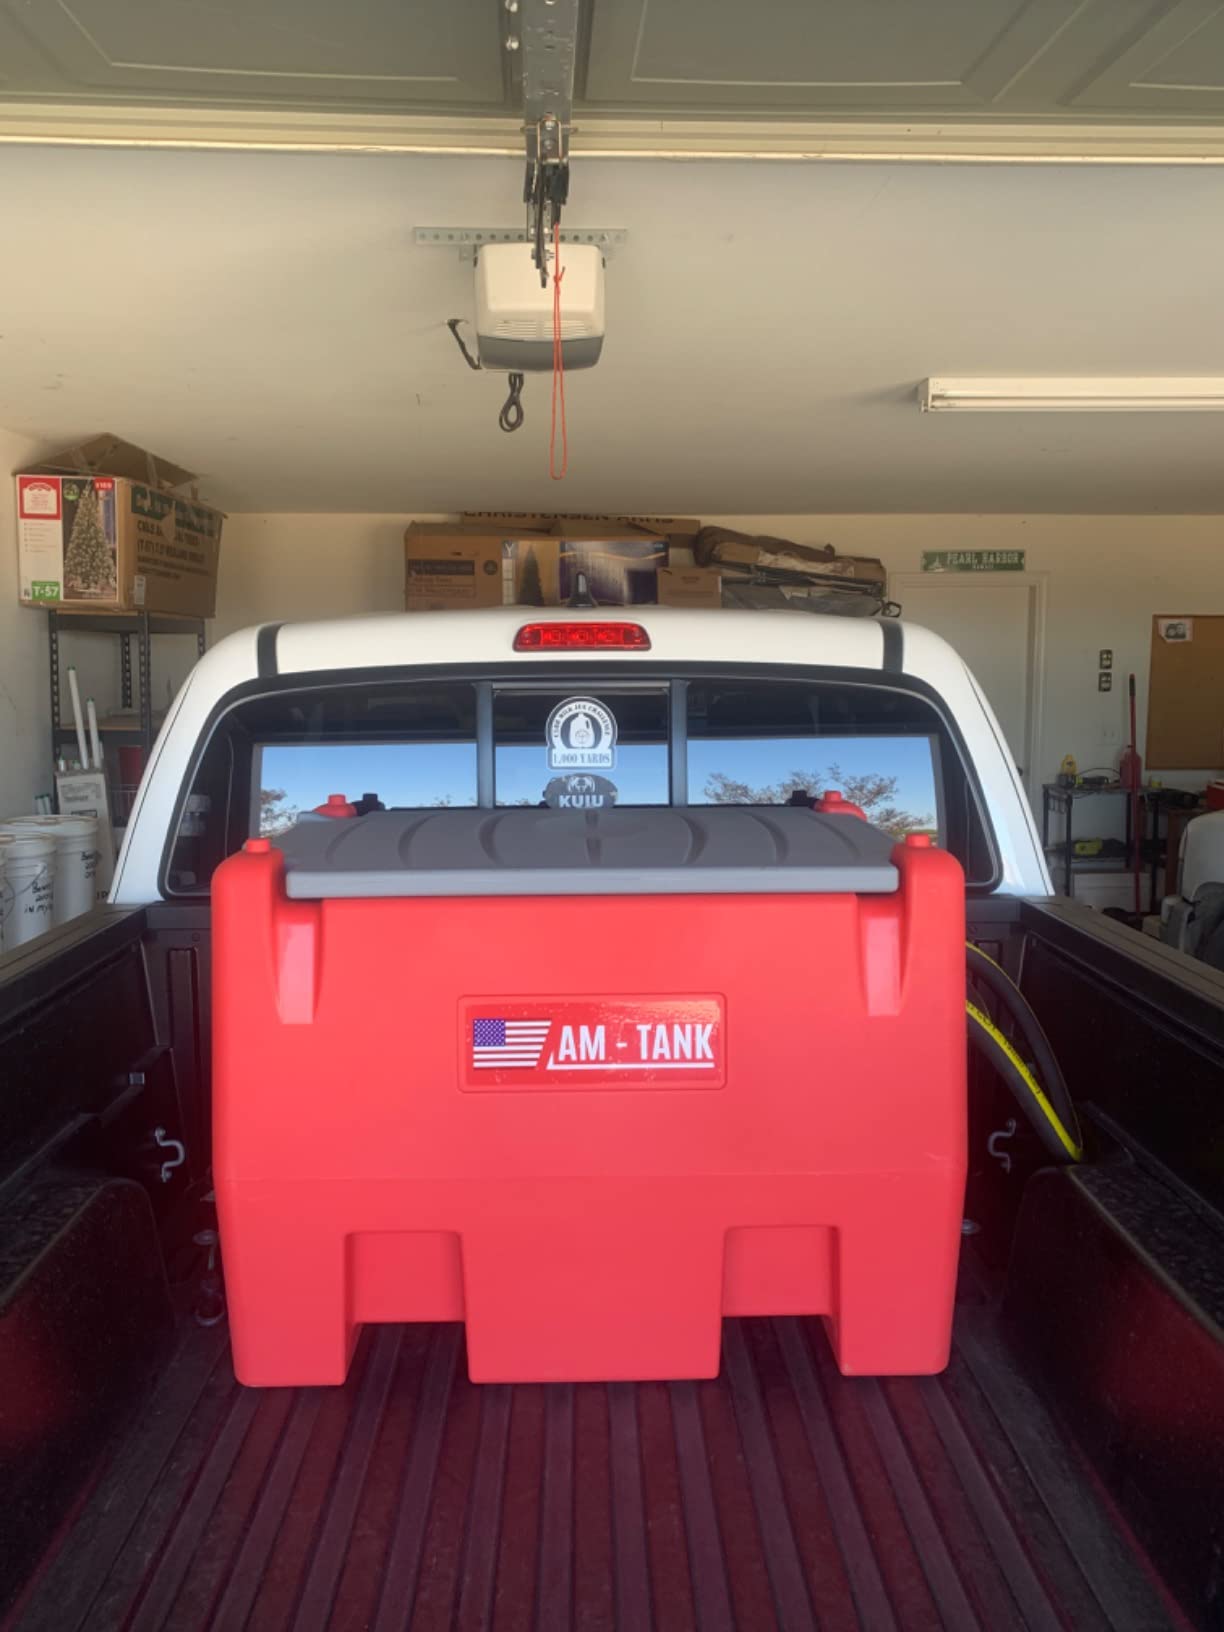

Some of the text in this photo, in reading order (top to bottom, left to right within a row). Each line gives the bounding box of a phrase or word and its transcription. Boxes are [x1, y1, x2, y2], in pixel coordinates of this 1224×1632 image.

[554, 753, 610, 764] 1,000 YARDS
[559, 795, 604, 808] KUIU
[558, 1025, 606, 1061] AM
[636, 1023, 714, 1060] TANK
